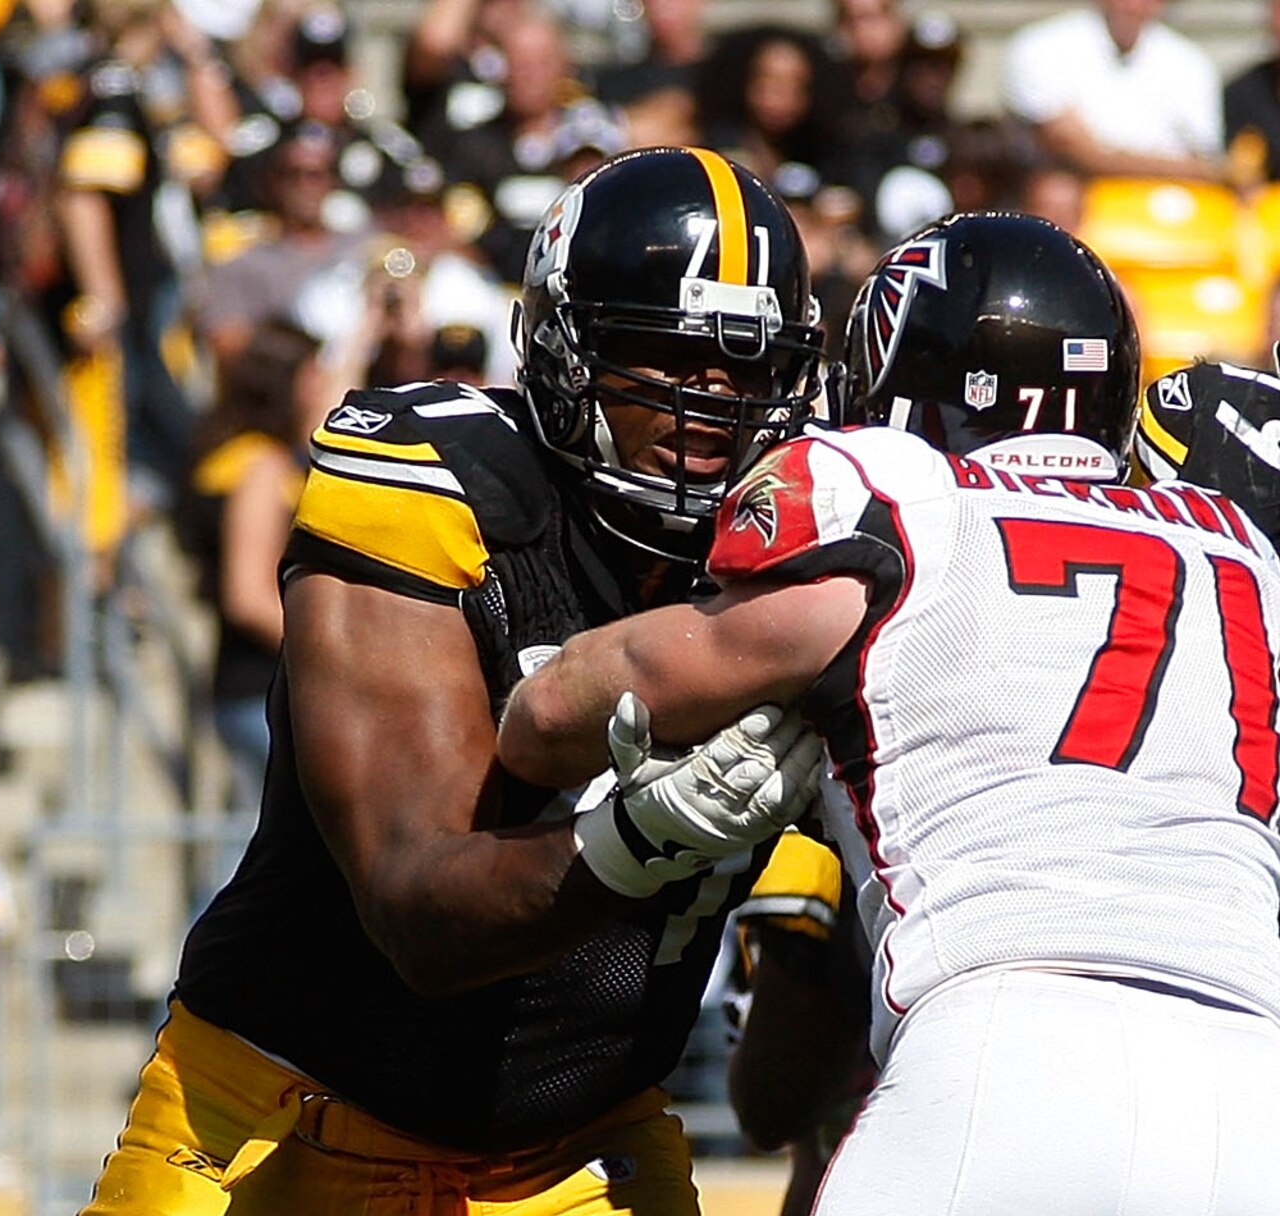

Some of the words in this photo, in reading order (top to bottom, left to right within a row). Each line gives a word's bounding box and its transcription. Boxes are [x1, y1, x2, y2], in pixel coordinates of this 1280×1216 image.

[684, 217, 770, 286] 71
[969, 386, 993, 402] NFL
[1019, 388, 1077, 430] 71
[989, 453, 1104, 468] FALCONS
[994, 516, 1280, 829] 71
